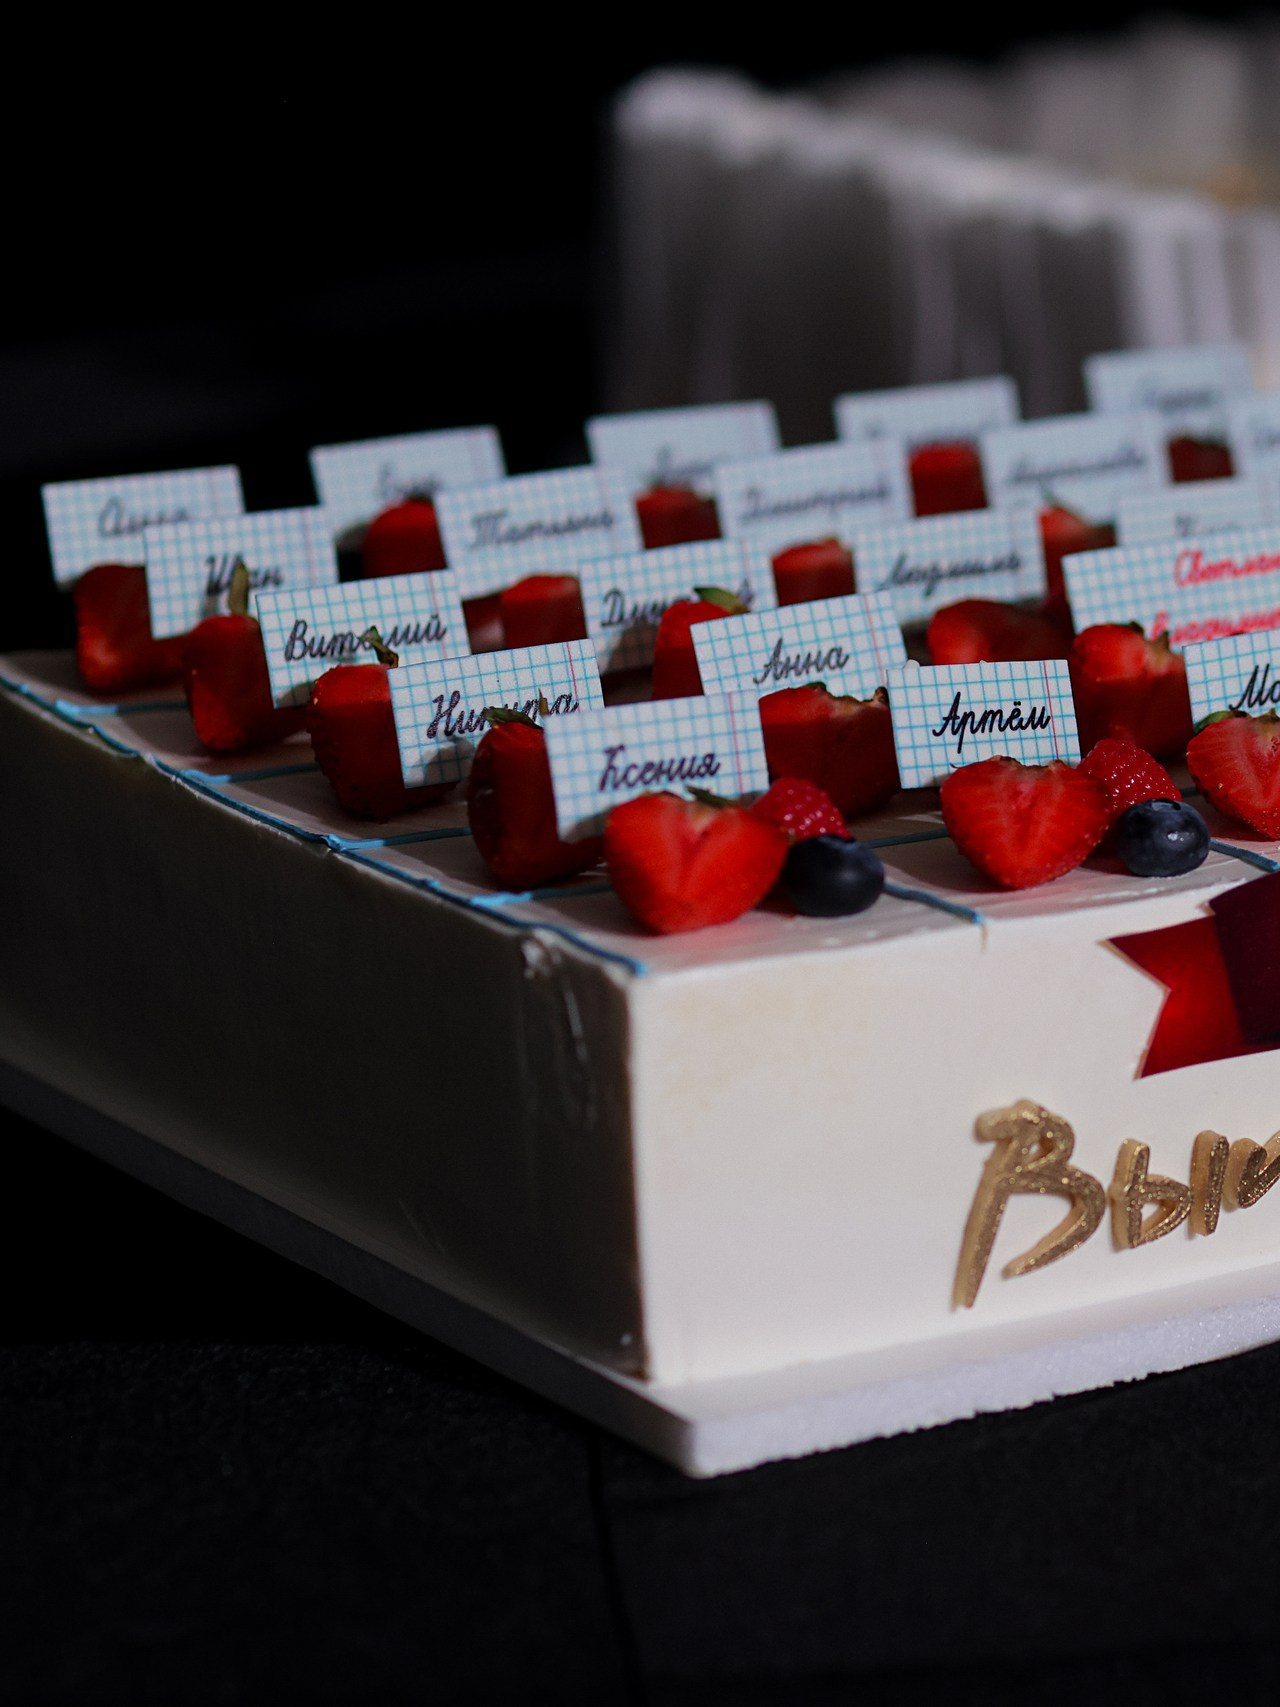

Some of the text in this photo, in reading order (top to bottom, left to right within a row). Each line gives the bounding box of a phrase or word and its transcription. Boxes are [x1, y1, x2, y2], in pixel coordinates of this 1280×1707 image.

[204, 553, 283, 597] Иан
[284, 613, 447, 662] Виталий
[750, 637, 847, 685] Анна
[930, 691, 1048, 754] Артём
[596, 744, 720, 793] Ксения
